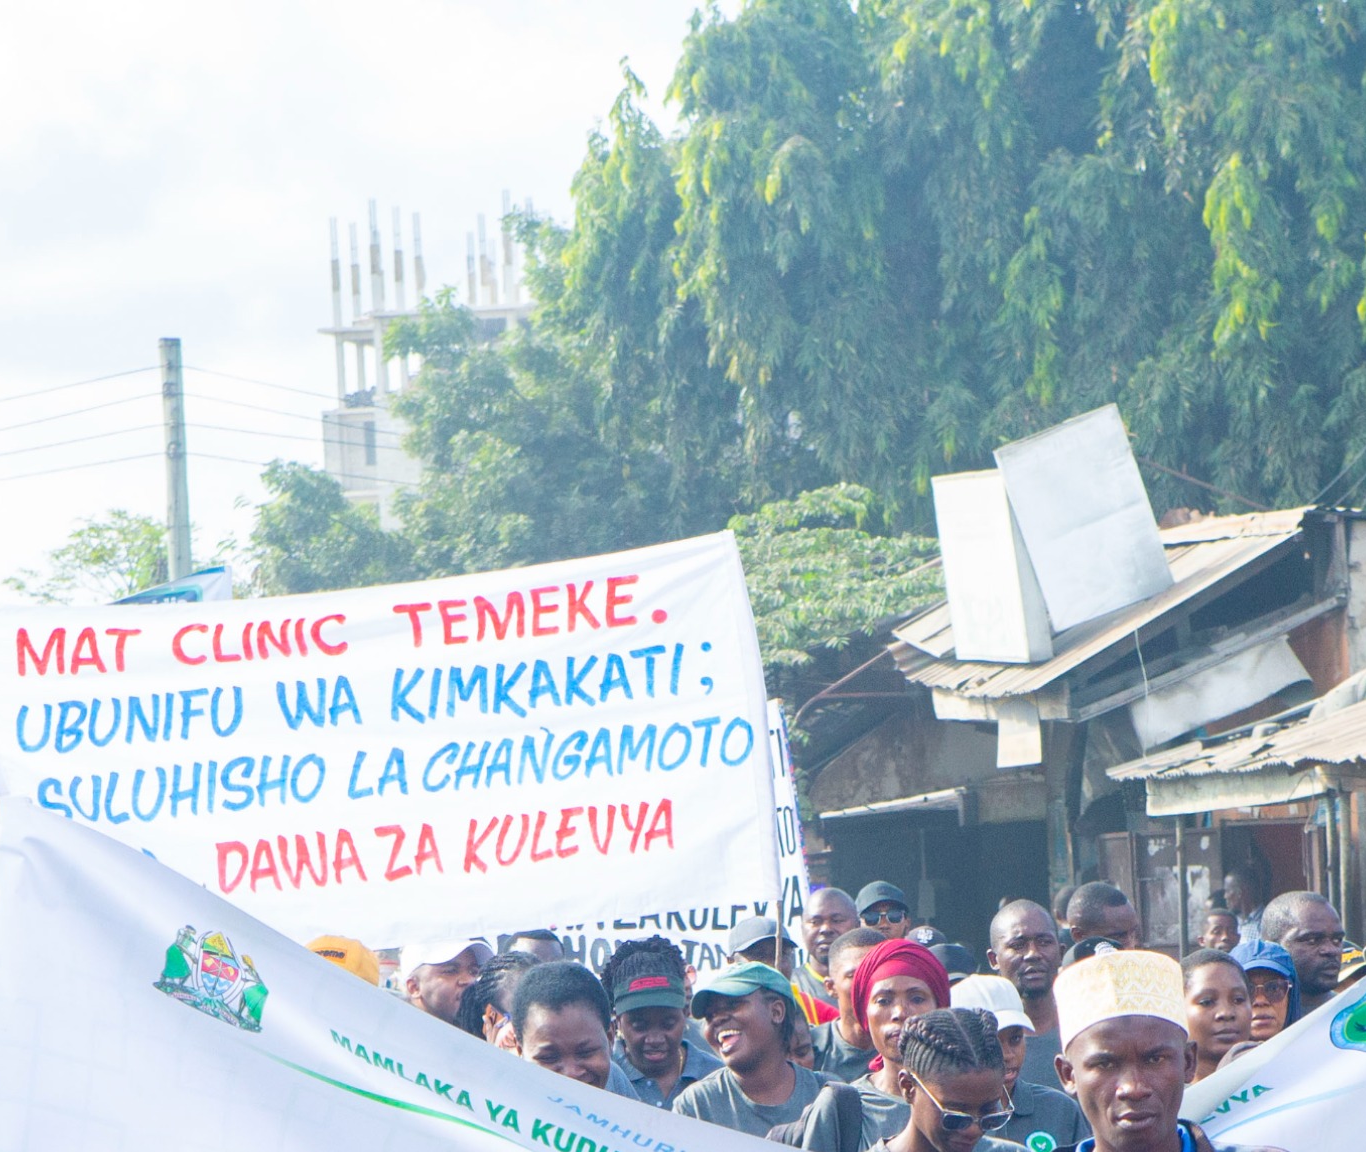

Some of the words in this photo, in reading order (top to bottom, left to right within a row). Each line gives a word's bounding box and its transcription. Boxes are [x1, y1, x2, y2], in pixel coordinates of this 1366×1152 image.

[16, 626, 141, 677] MAT
[172, 612, 348, 666] CLINIC
[392, 574, 668, 648] TEMEKE.
[16, 685, 243, 753] UBUNIFU
[276, 675, 363, 730] WA
[37, 753, 326, 824] SULUHISHO
[347, 747, 409, 800] LA
[422, 716, 754, 793] CHANGAMOTO
[215, 828, 368, 894] DAWA
[374, 822, 444, 881] ZA
[464, 798, 674, 874] KULEVYA
[330, 1028, 475, 1112] MAMLAKA
[485, 1098, 521, 1133] YA
